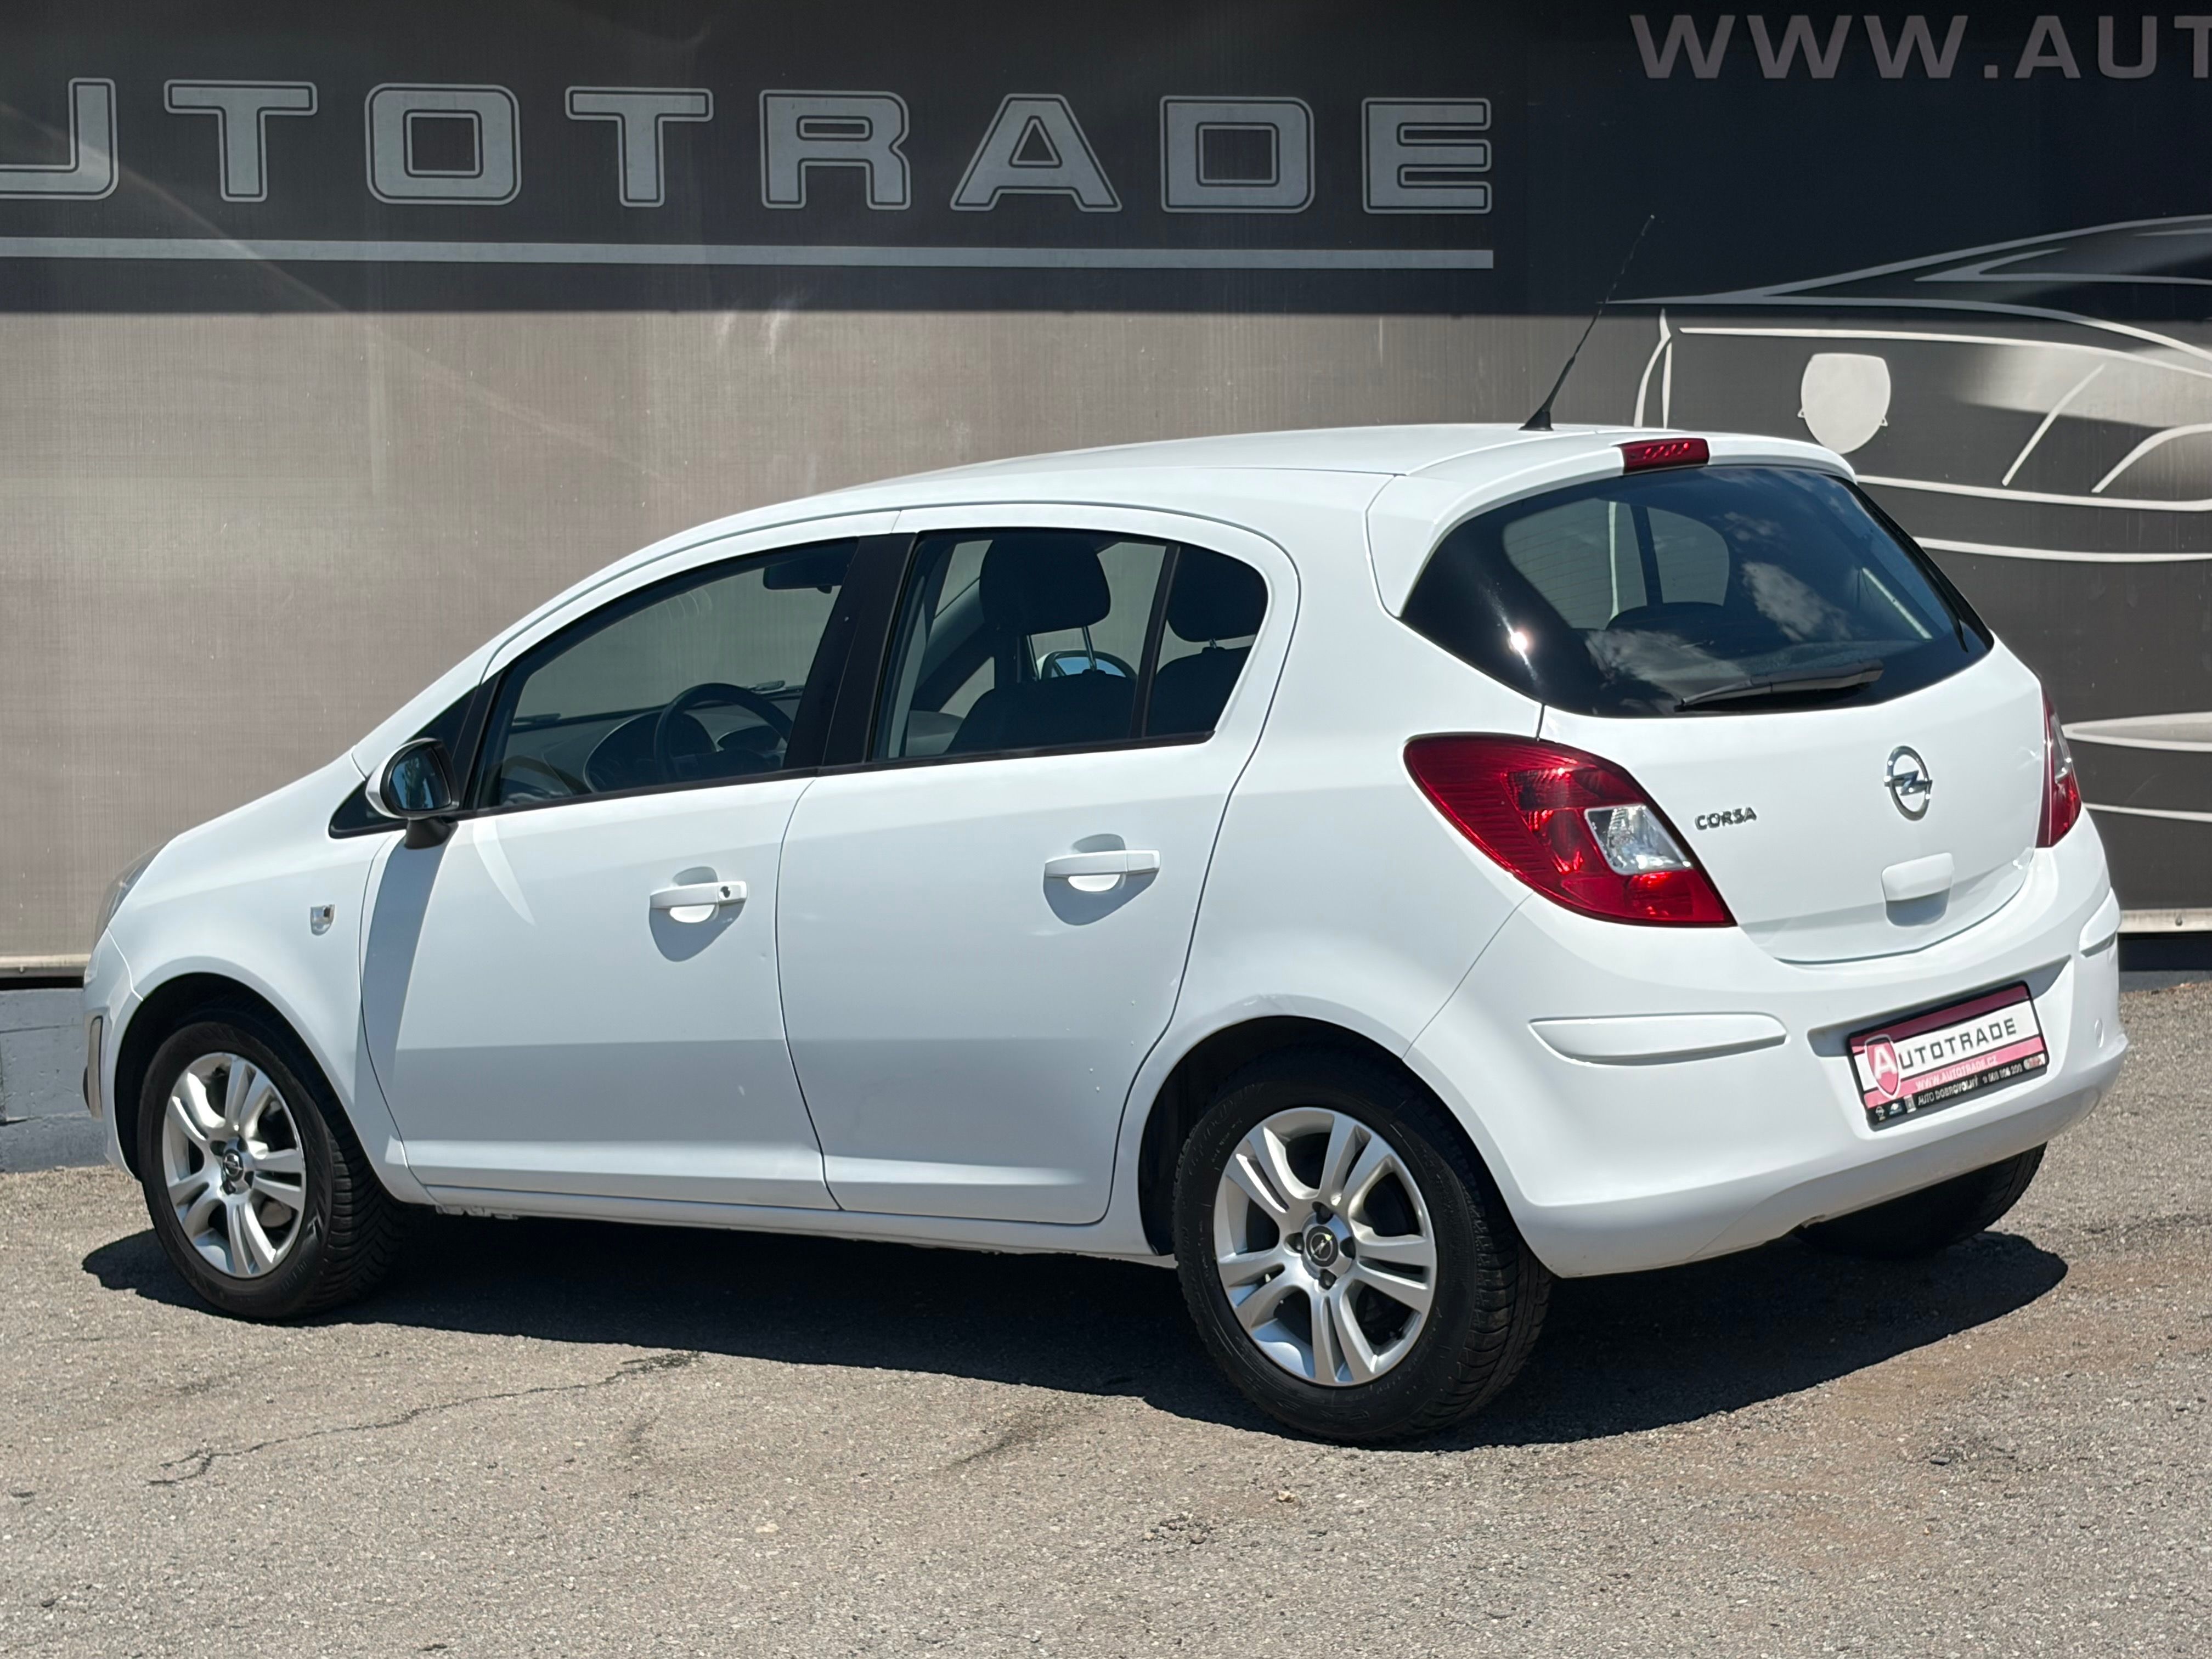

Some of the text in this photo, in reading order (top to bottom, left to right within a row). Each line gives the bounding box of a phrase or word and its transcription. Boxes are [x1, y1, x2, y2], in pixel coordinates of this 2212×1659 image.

[1695, 806, 1757, 831] CORSA
[1873, 1018, 2017, 1079] AUTOTRADE
[1918, 1091, 1934, 1105] AUTO
